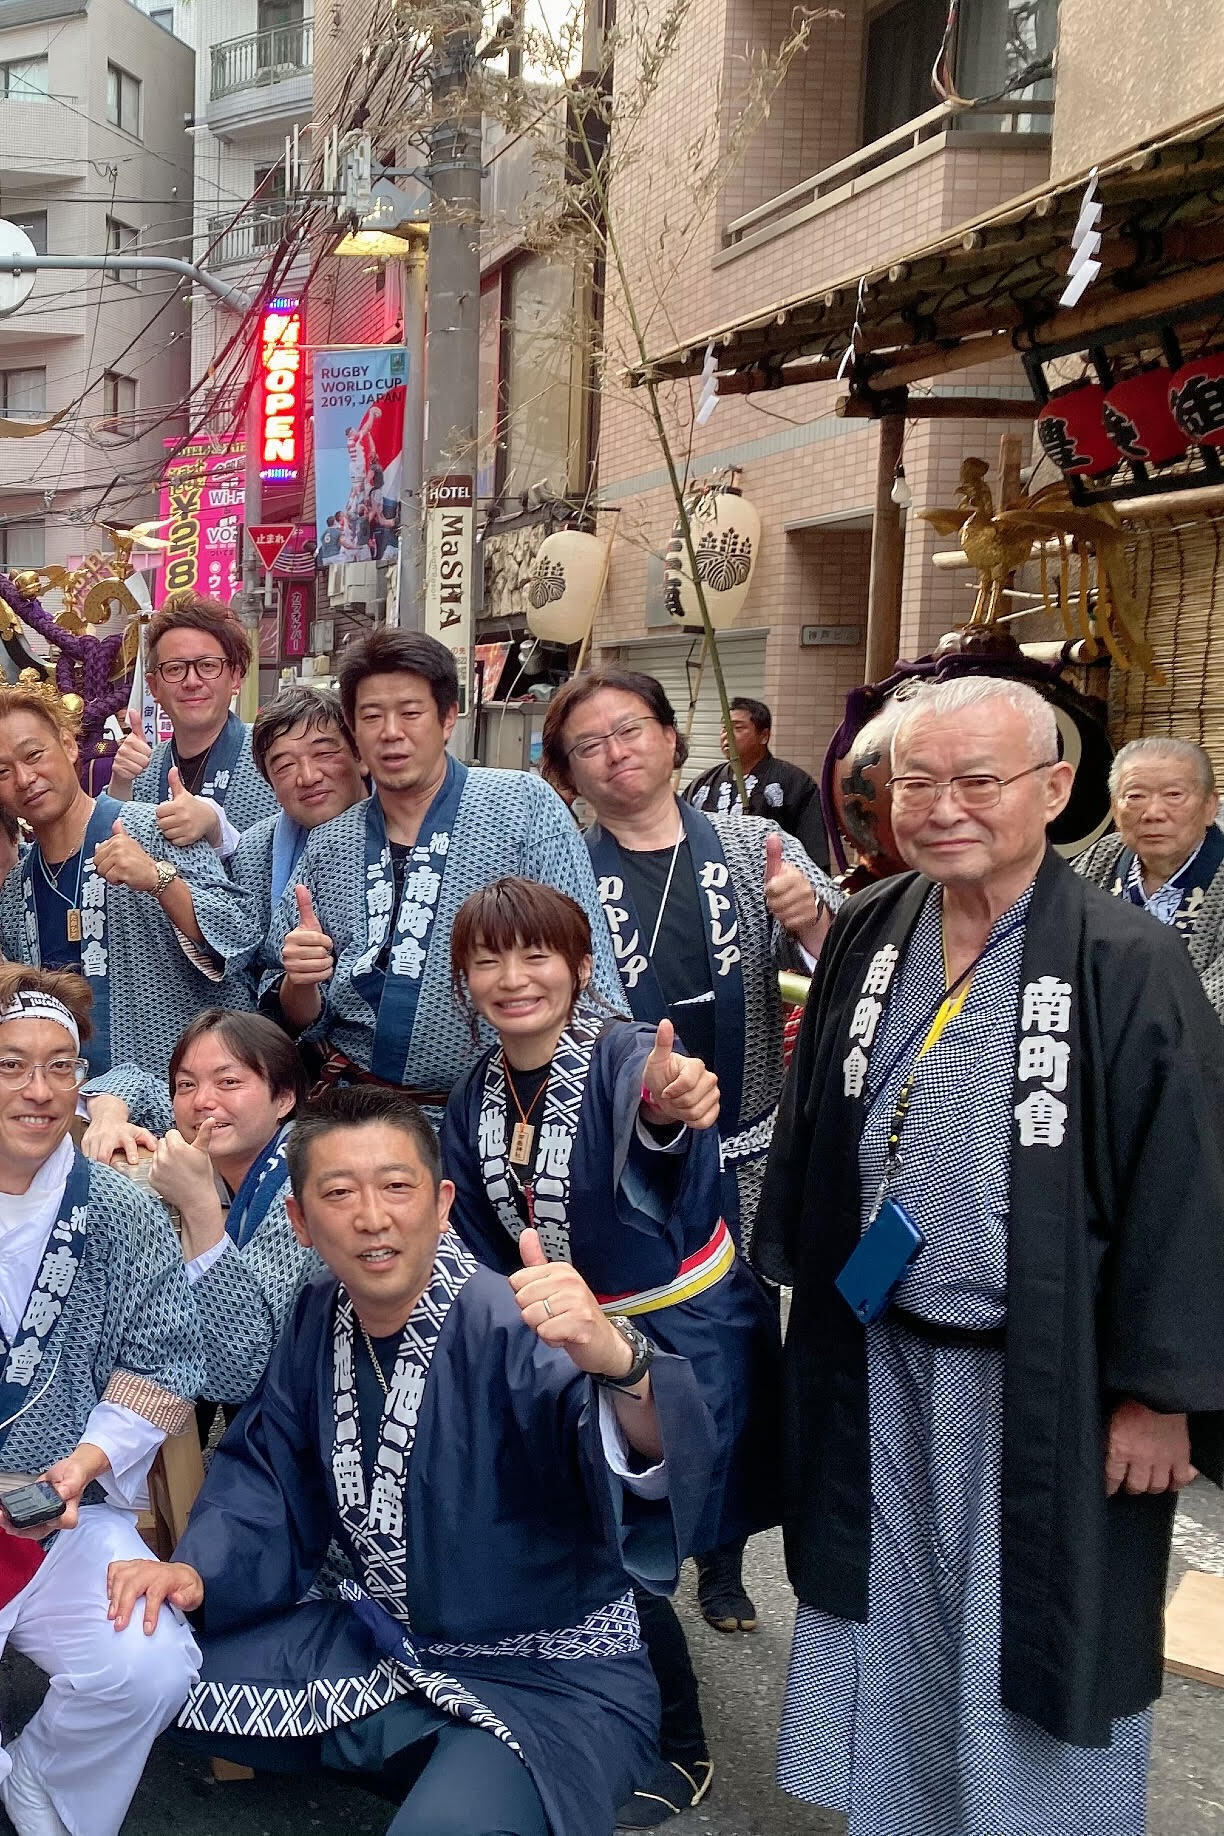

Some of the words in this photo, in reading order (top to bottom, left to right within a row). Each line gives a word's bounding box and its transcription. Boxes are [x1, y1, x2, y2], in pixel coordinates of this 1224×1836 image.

[321, 366, 370, 379] RUGBY
[321, 380, 373, 393] WORLD
[375, 377, 402, 391] CUP
[321, 395, 356, 408] 2019,
[358, 391, 402, 406] JAPAN
[429, 486, 471, 500] HOTEL
[255, 533, 286, 544] 止まれ
[698, 861, 742, 976] カトレア
